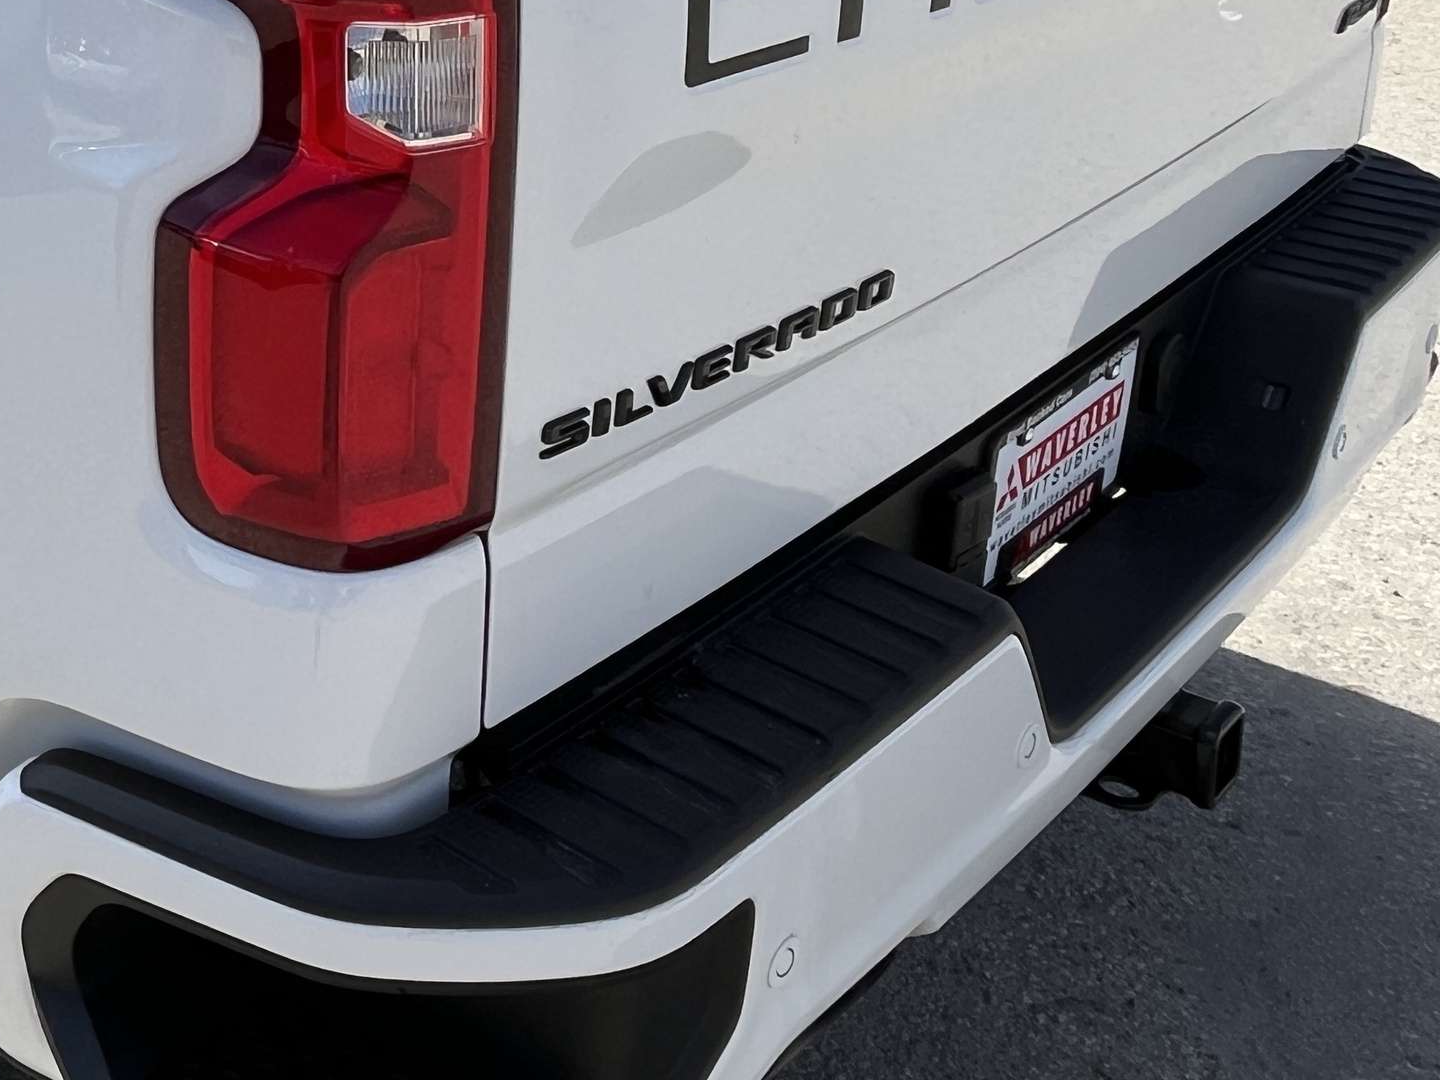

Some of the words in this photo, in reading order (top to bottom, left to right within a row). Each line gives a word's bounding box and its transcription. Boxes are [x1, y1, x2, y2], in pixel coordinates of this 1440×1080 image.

[539, 269, 895, 460] SILVERADO
[1021, 421, 1118, 510] MITSUBISHI
[1025, 386, 1124, 483] WAVERLEY
[1029, 482, 1095, 548] WAVERLEY
